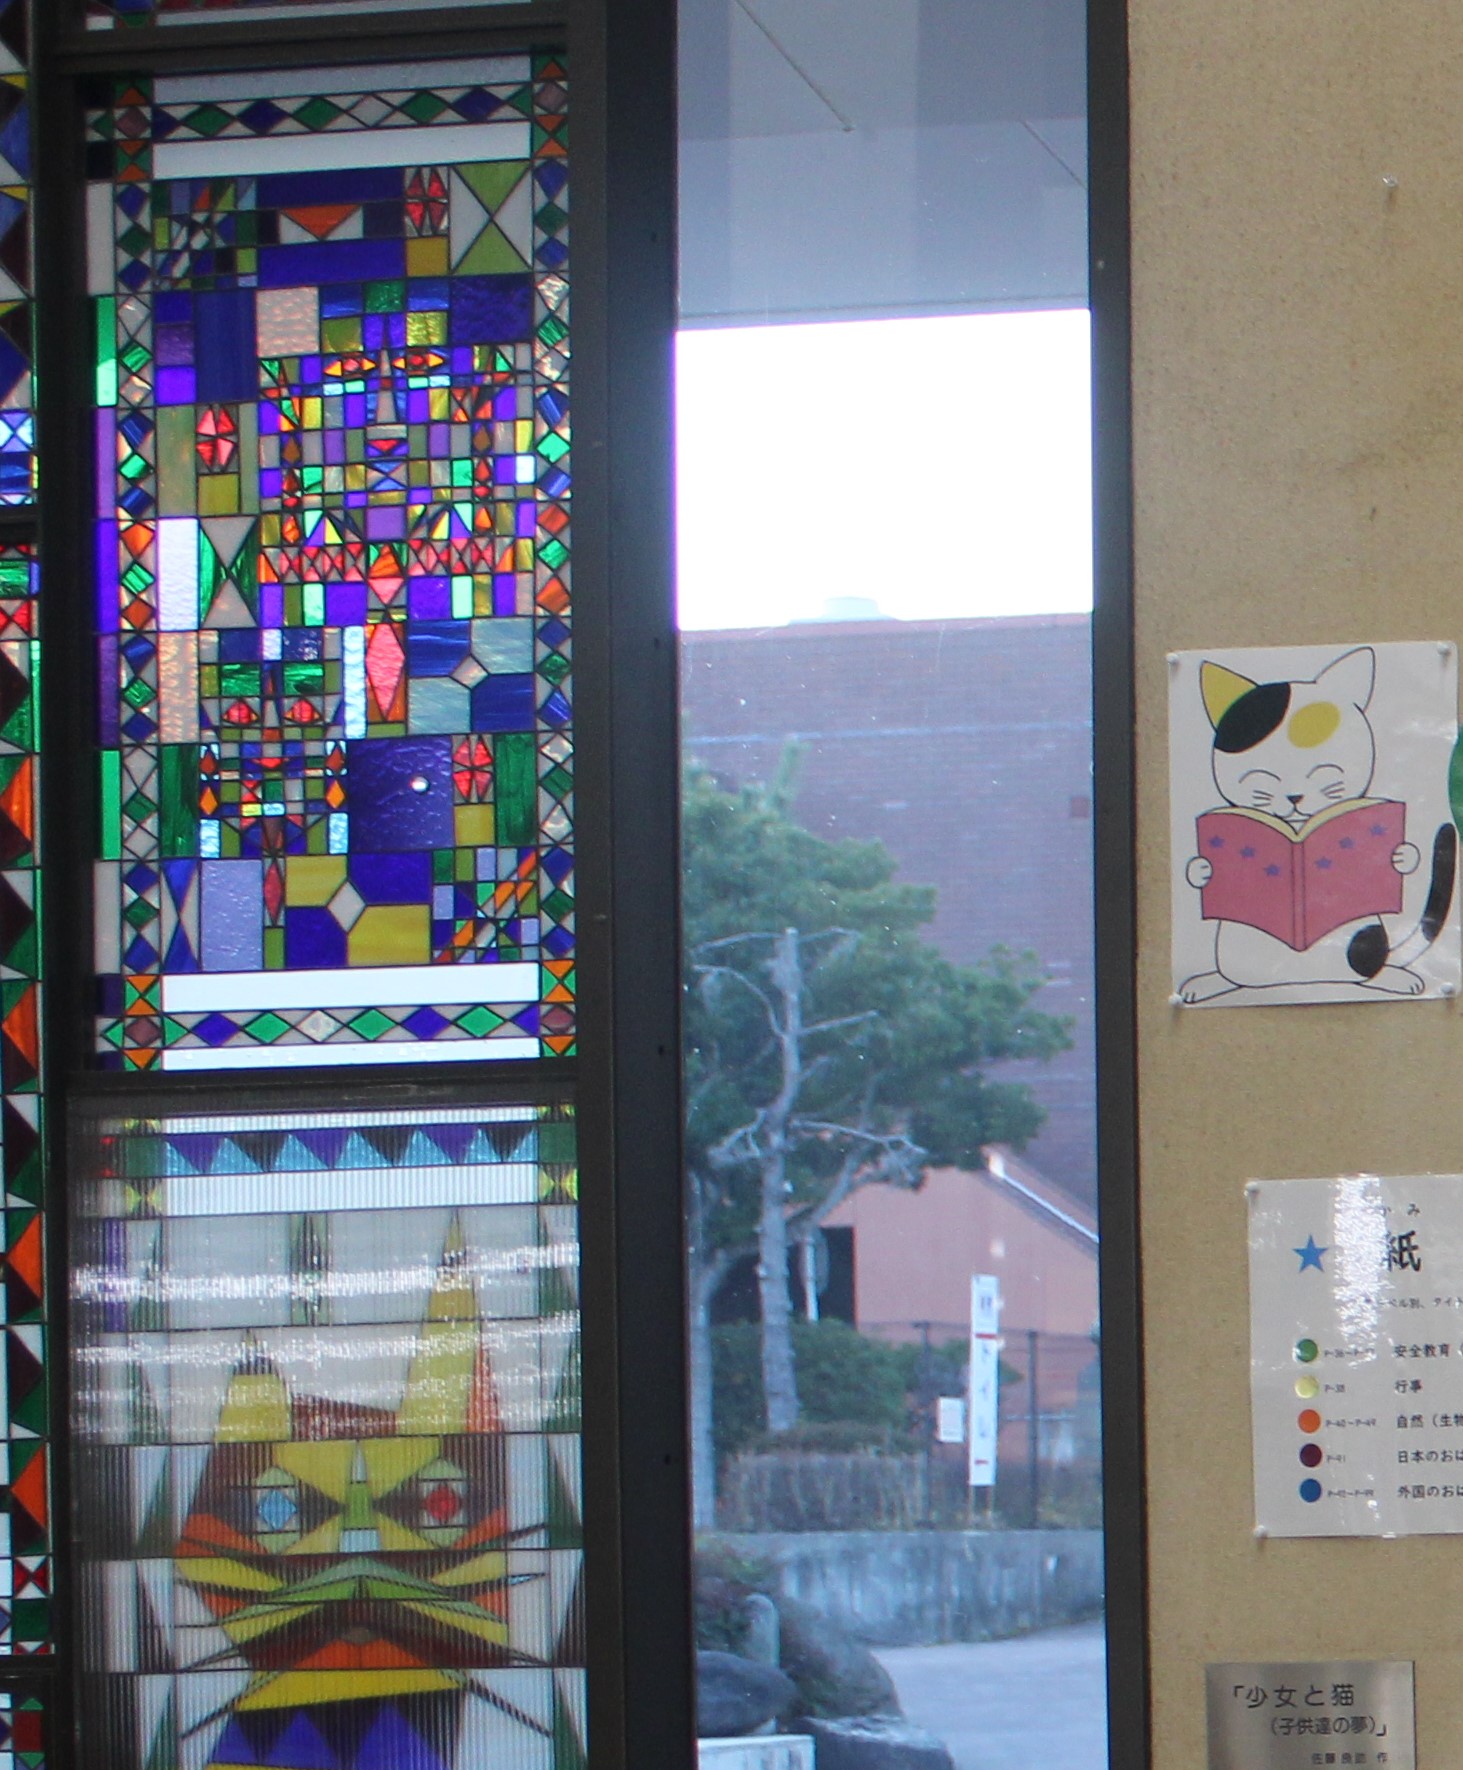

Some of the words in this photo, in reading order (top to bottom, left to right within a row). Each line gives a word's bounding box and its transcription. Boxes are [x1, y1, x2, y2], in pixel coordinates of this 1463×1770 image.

[1395, 1379, 1423, 1395] 行事
[1233, 1684, 1354, 1708] 「少女と猫
